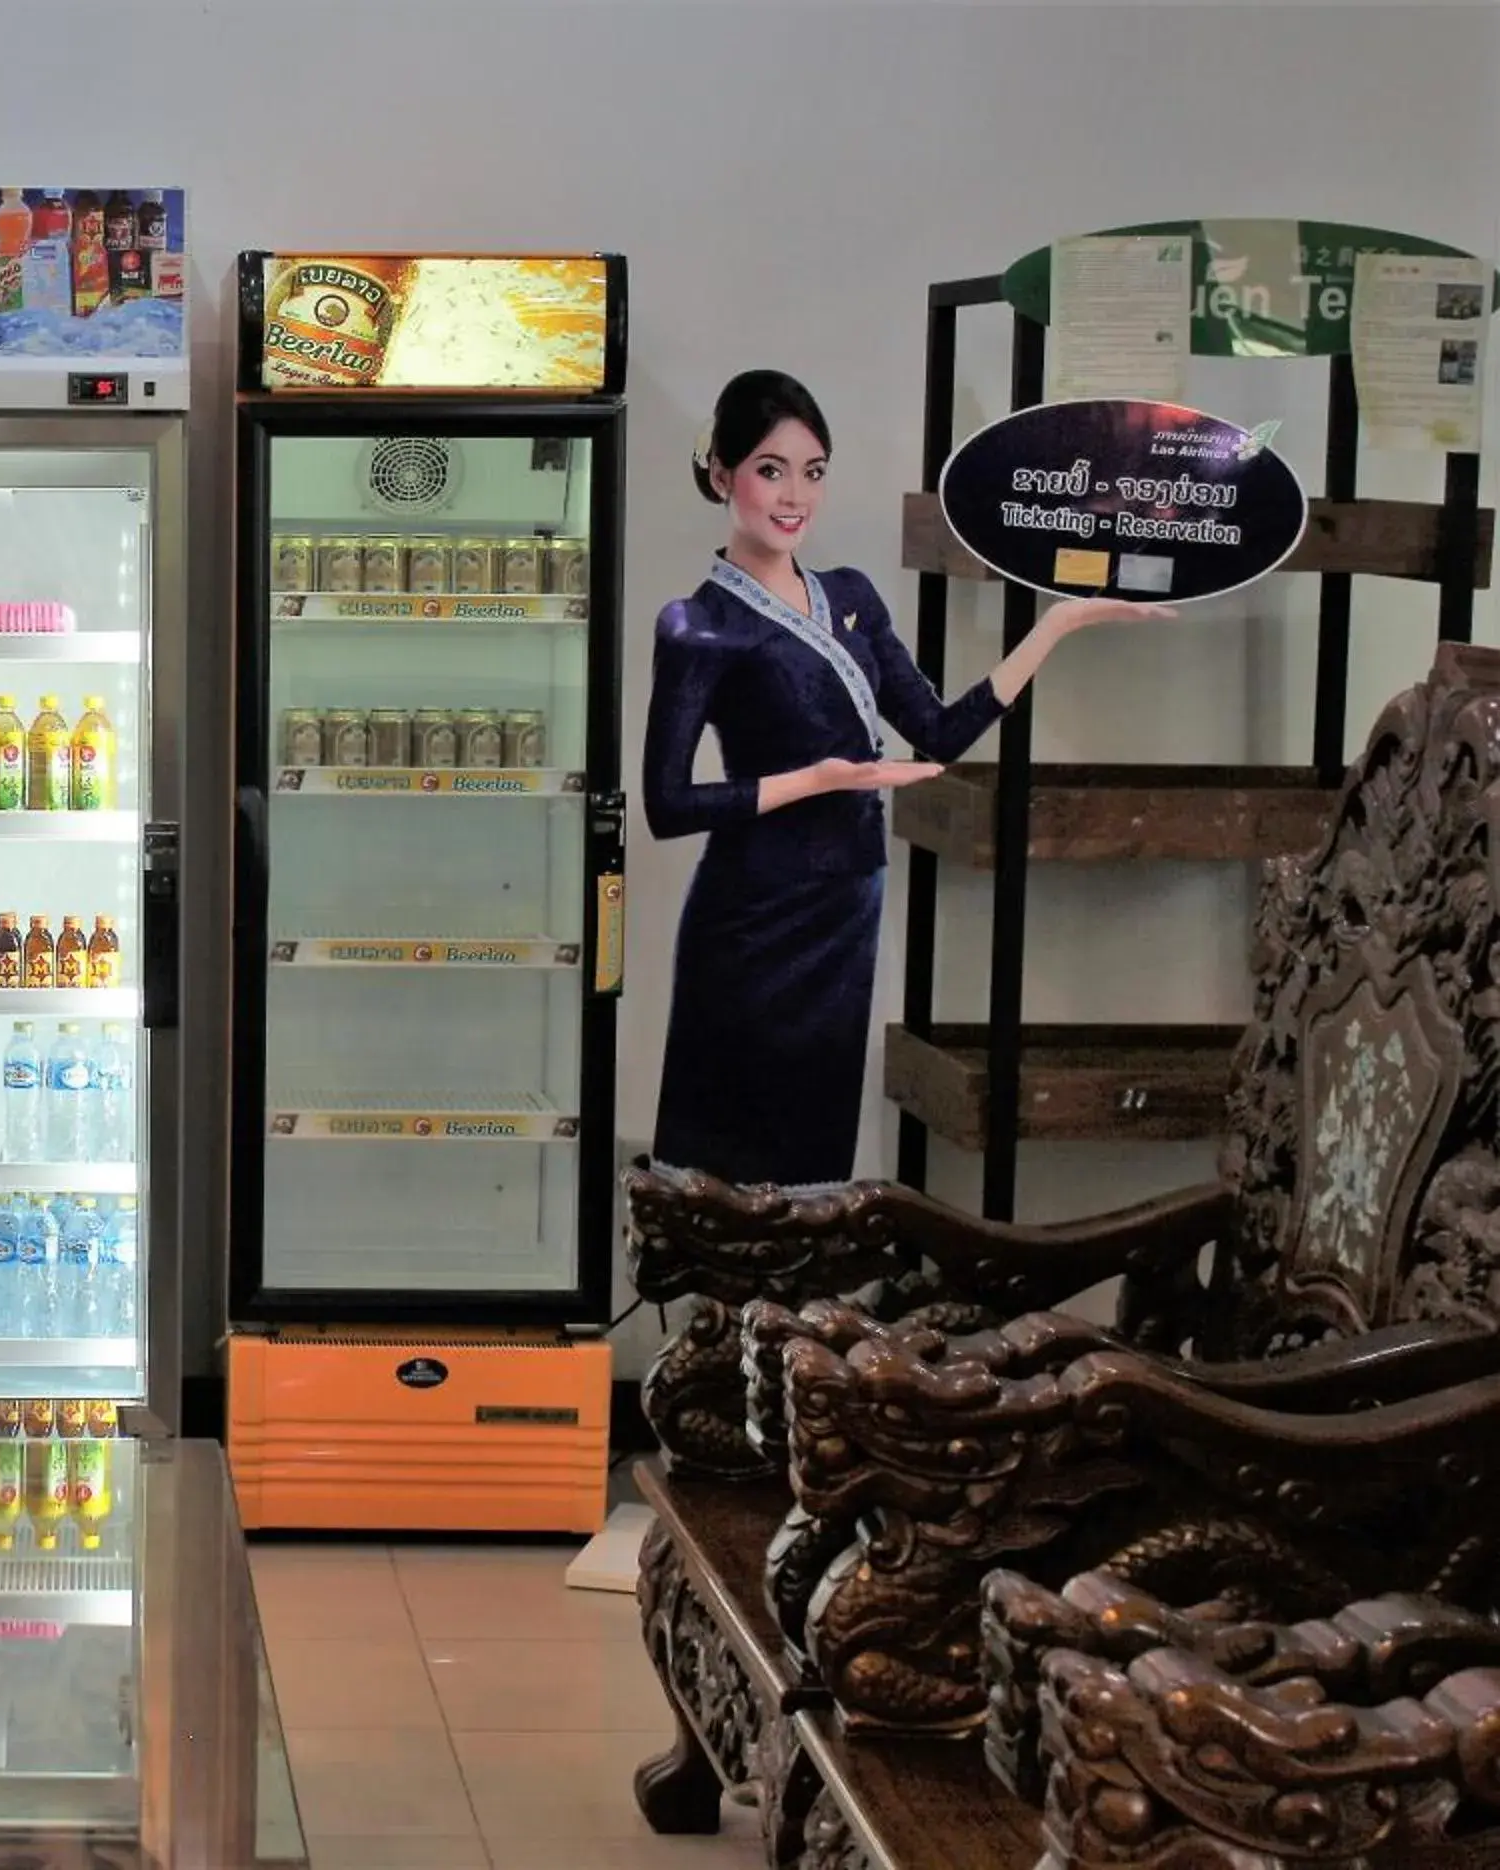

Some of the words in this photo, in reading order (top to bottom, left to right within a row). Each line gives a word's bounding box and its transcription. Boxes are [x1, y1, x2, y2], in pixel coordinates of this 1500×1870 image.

[265, 322, 377, 373] Beerlao
[1151, 443, 1176, 456] Lao
[1178, 445, 1230, 459] Airlines
[1000, 501, 1096, 538] Ticketing
[1115, 511, 1242, 545] Reservation
[453, 603, 526, 619] Beerlao
[452, 777, 528, 793] Beerlao
[445, 946, 516, 963] Beerlao
